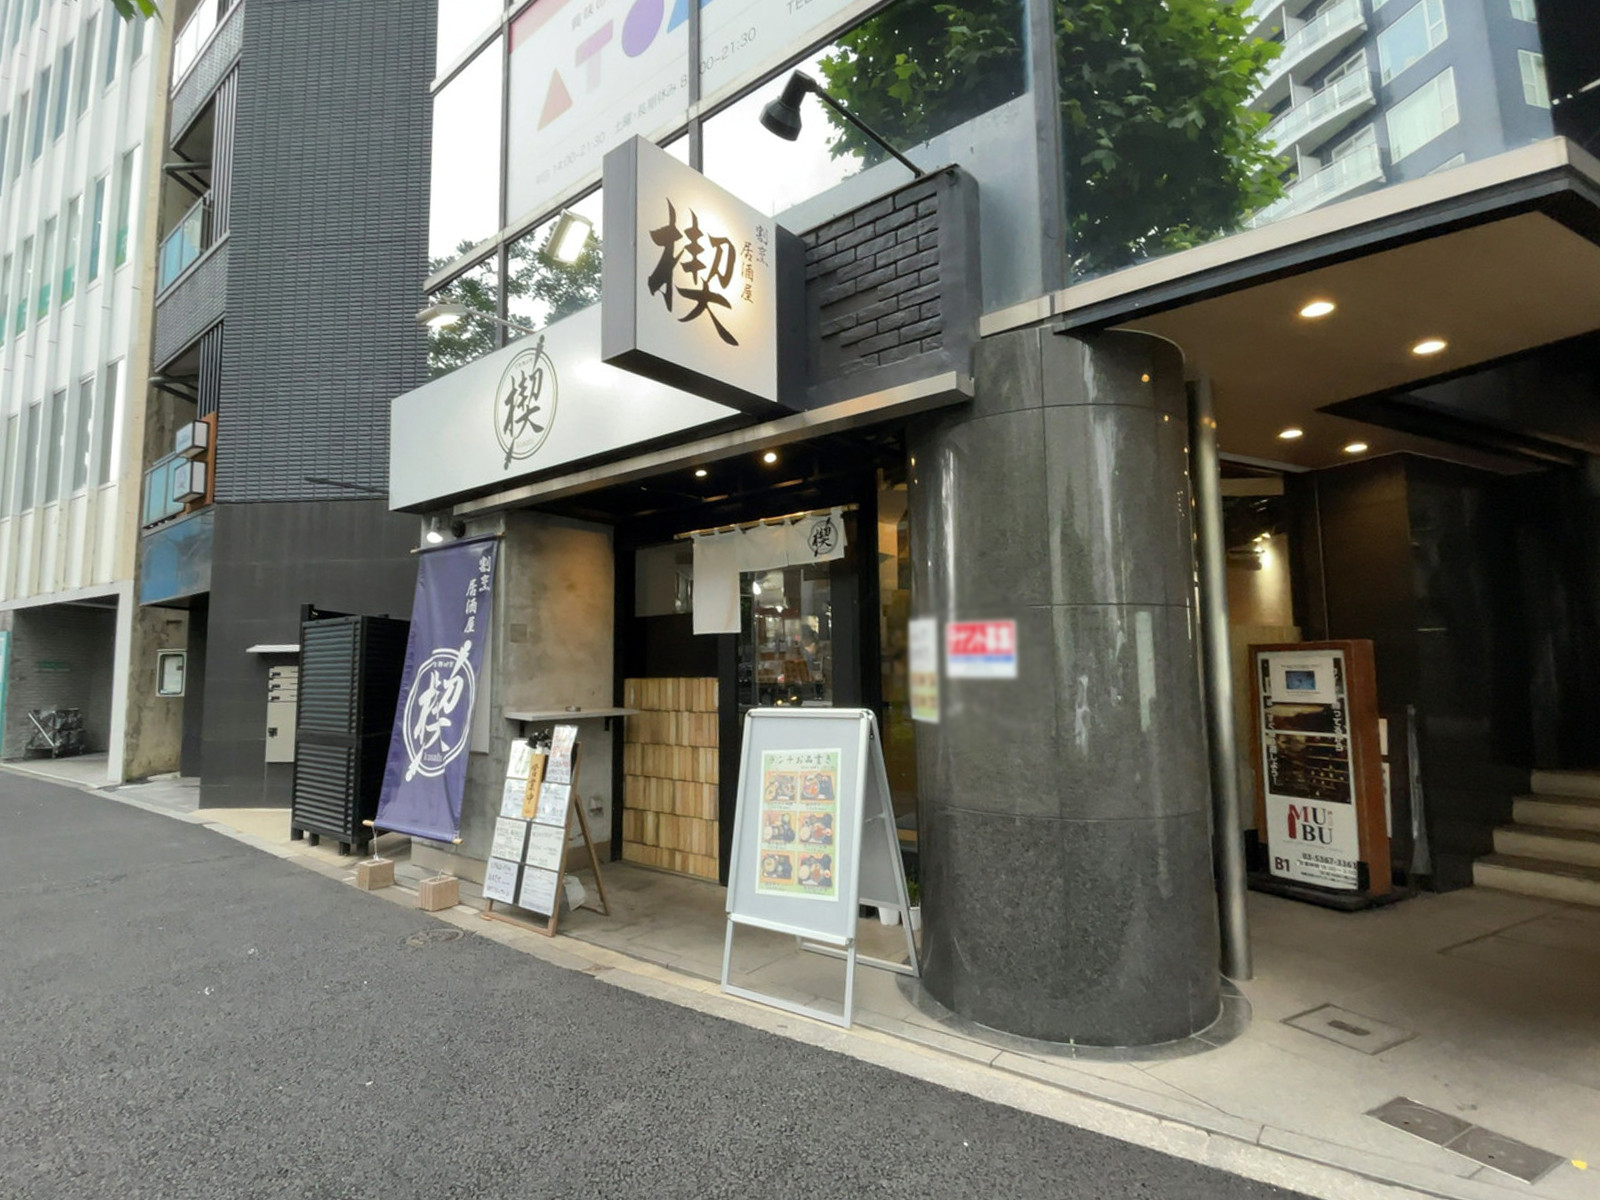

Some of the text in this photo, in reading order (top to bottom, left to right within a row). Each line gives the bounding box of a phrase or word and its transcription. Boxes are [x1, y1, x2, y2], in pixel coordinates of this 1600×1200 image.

[648, 197, 739, 346] 楔
[740, 241, 754, 304] 居酒屋
[503, 367, 544, 440] 楔
[464, 578, 478, 633] 居酒屋
[414, 669, 464, 753] 楔
[1274, 856, 1291, 872] B1
